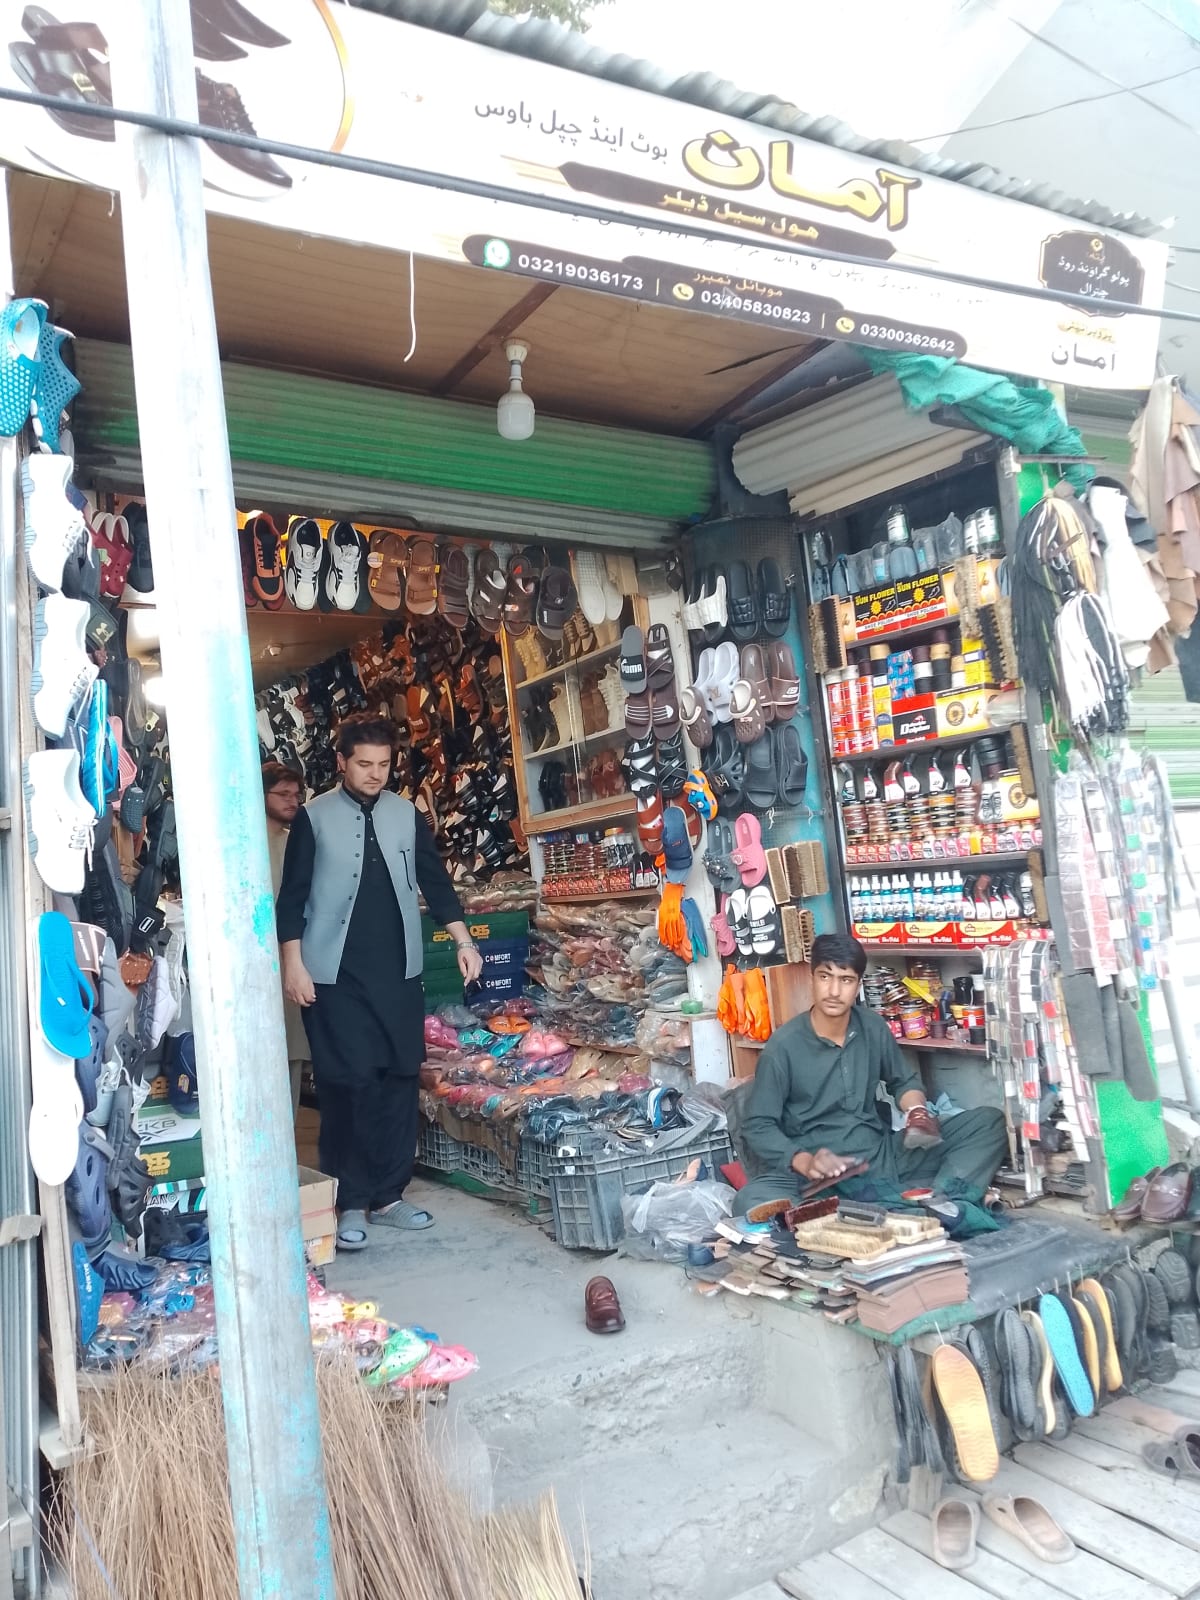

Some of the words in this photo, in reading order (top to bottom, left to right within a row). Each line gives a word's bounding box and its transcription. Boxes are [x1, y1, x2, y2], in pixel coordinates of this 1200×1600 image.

[540, 109, 582, 147] چپل
[589, 115, 623, 152] اینڈ
[630, 132, 667, 165] بوٹ
[714, 202, 766, 226] سیل
[518, 254, 644, 290] 03219036173
[1059, 256, 1076, 272] روڈ
[735, 279, 783, 297] موبائل
[1110, 270, 1130, 287] پولو
[701, 290, 811, 323] 03405830823
[860, 323, 955, 352] 03300362642
[1051, 343, 1115, 371] امان
[896, 582, 911, 593] SUN
[912, 574, 939, 588] FLOWER
[855, 595, 869, 606] SUN
[869, 588, 896, 601] FLOWER
[621, 664, 643, 674] PUMA
